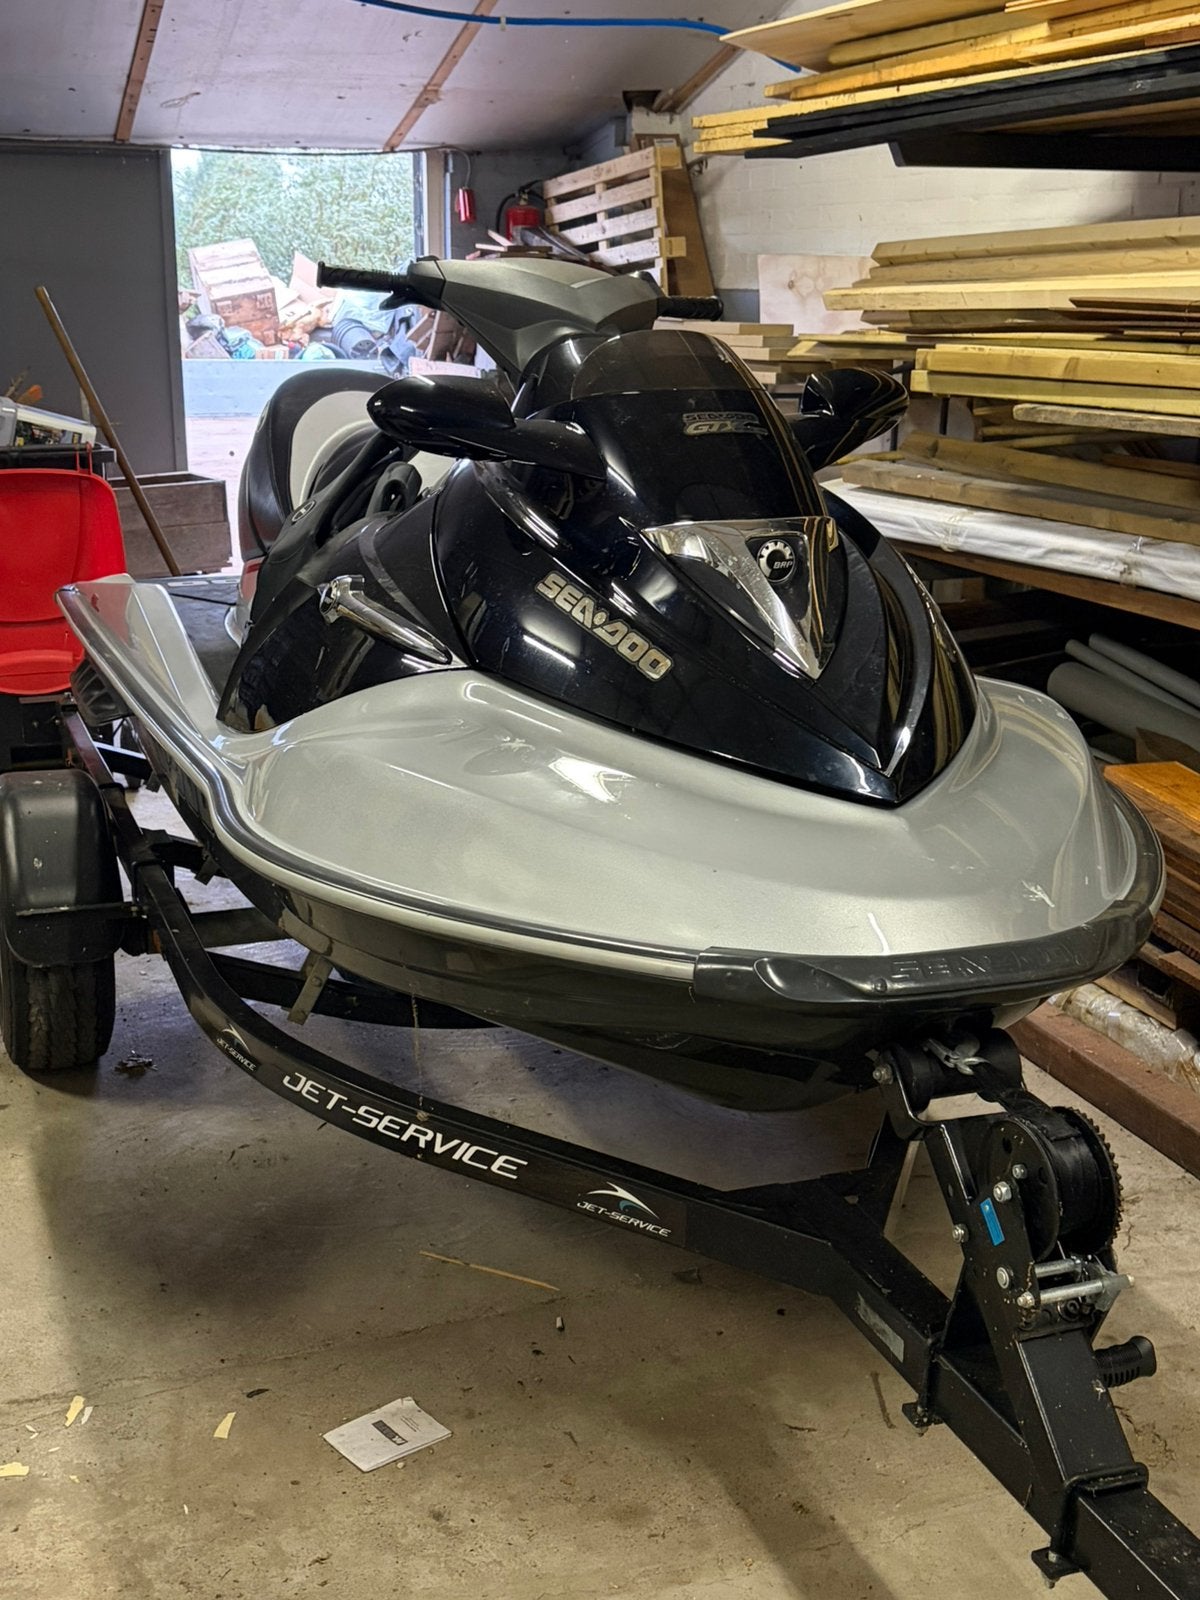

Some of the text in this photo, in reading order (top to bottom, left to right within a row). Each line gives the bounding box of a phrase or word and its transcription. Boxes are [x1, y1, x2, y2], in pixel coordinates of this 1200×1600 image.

[773, 561, 793, 569] BRP
[282, 1072, 529, 1179] JET-SERVICE
[577, 1201, 671, 1237] JET-SERVICE
